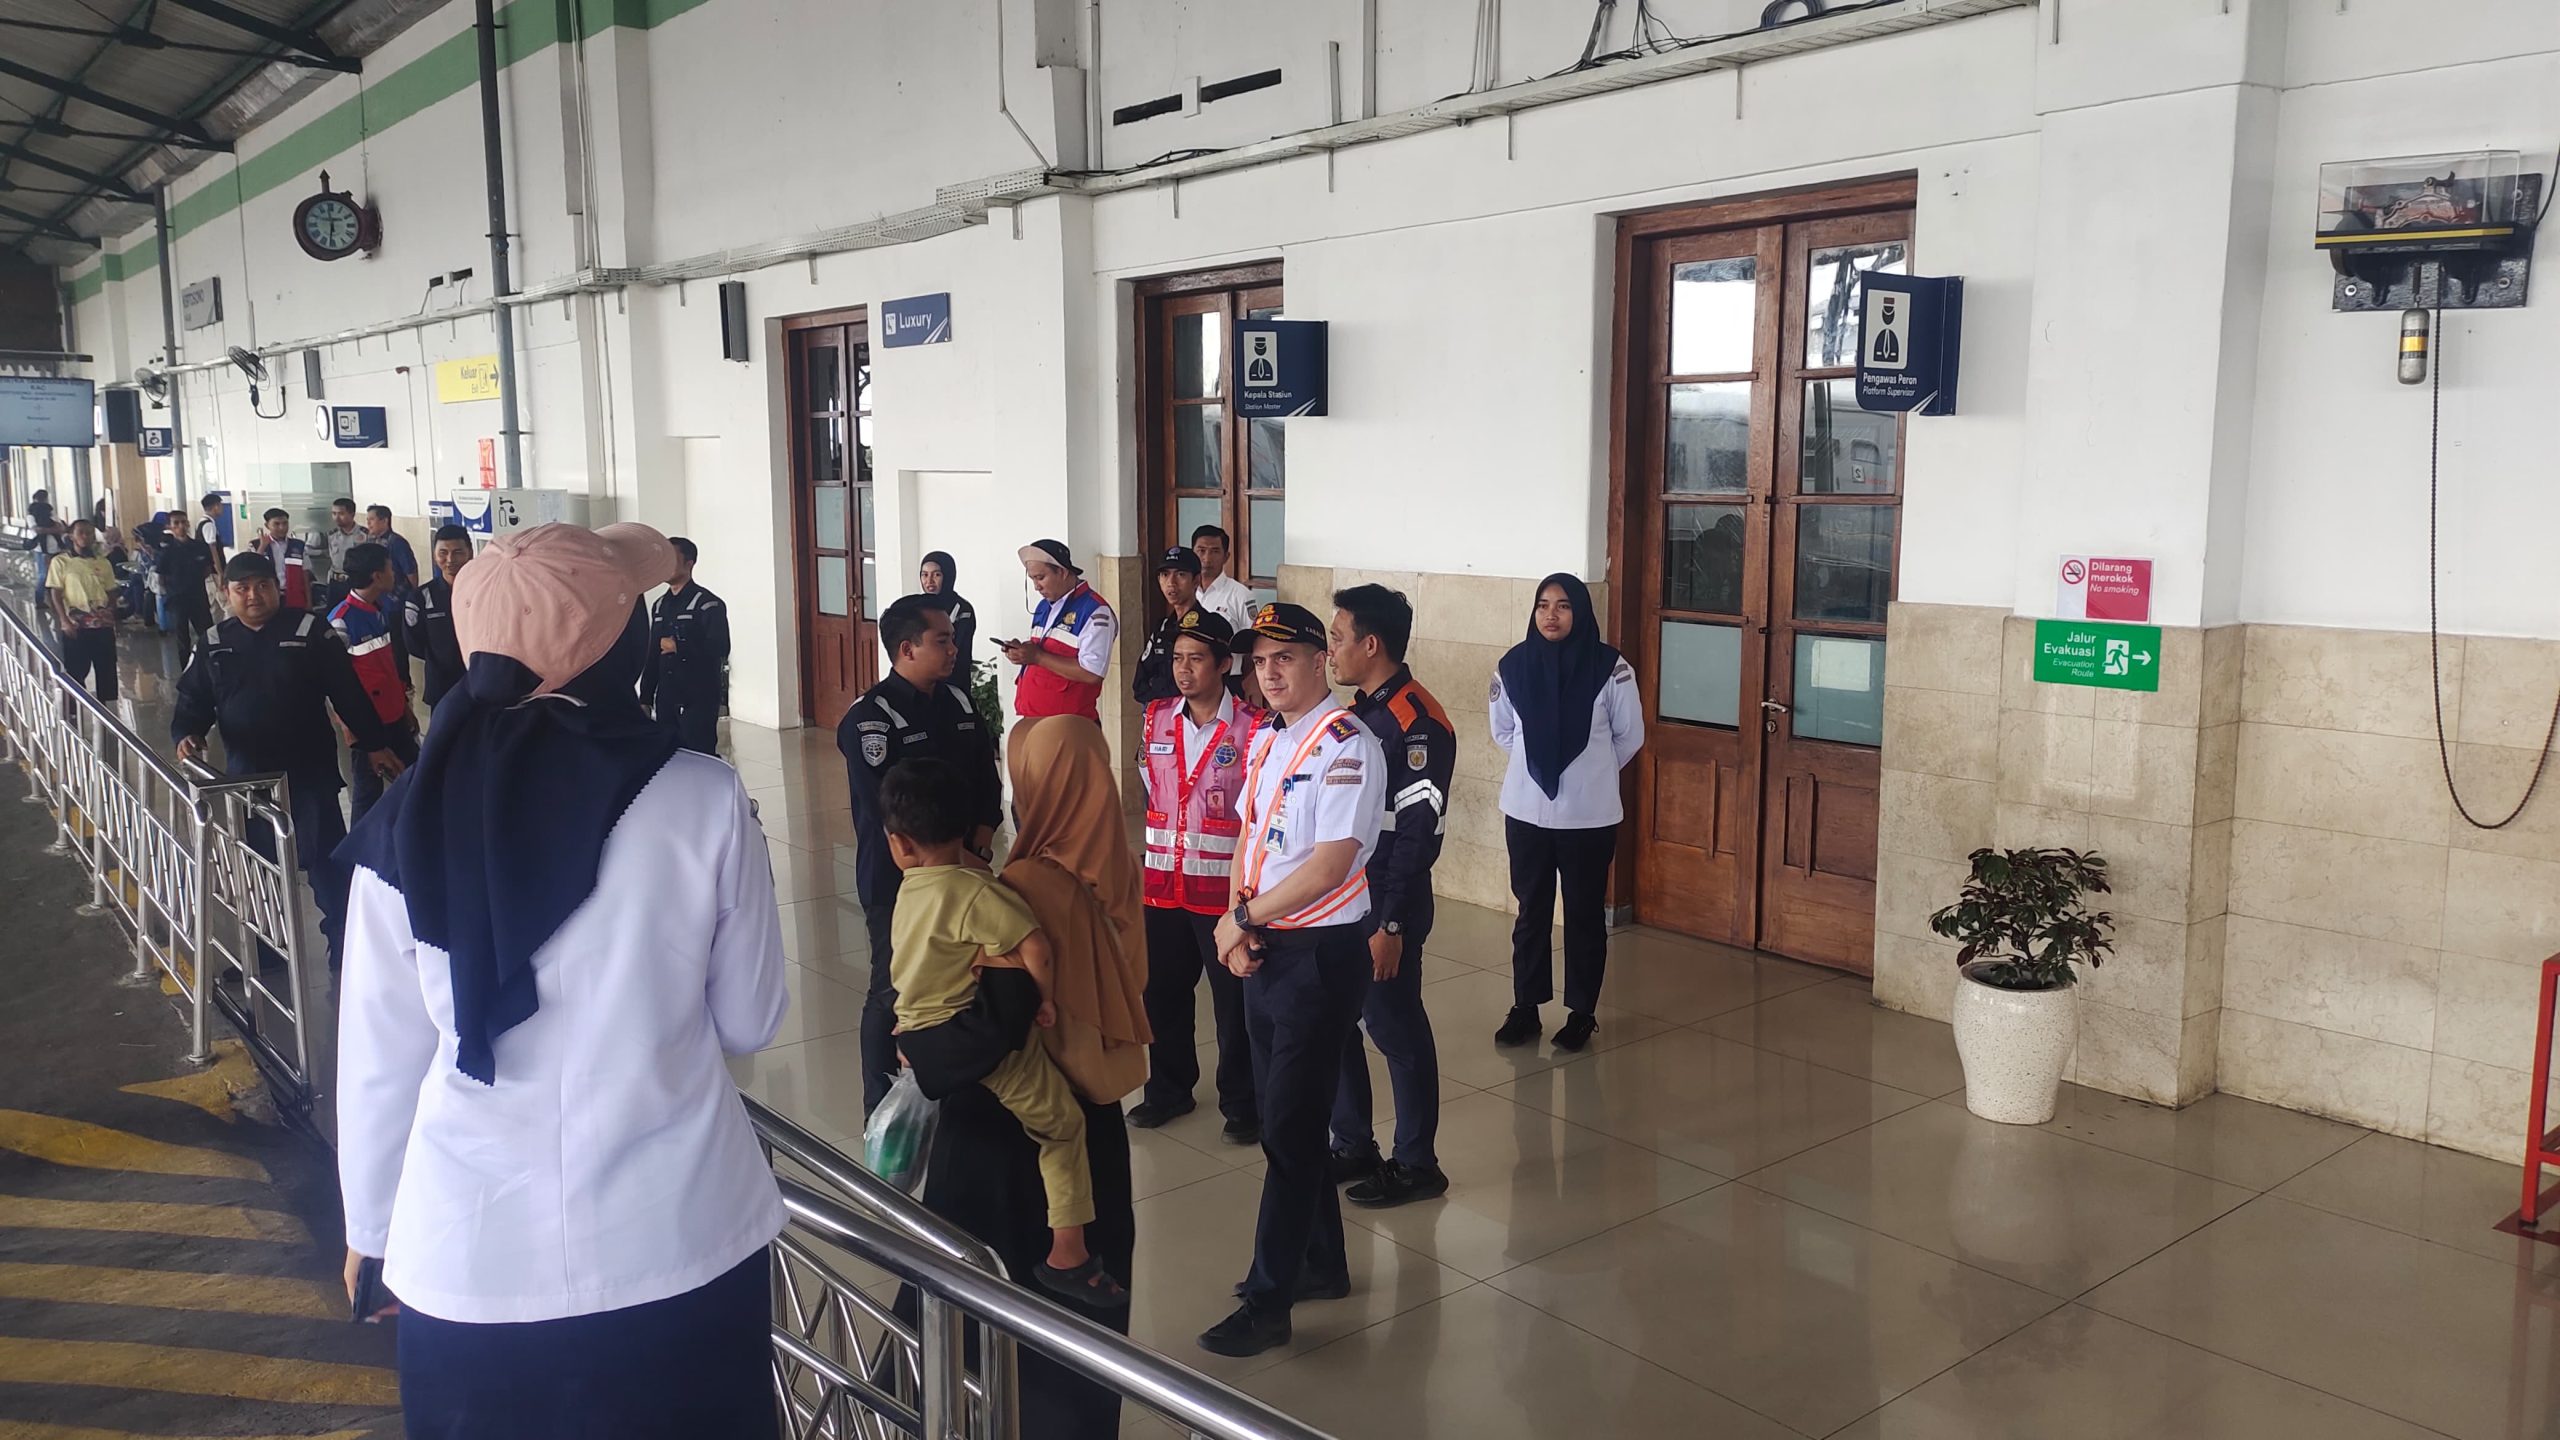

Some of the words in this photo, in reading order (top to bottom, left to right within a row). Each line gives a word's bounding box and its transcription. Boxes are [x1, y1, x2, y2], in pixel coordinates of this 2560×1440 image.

[899, 312, 932, 330] Luxury
[1863, 372, 1897, 386] Pengawas
[1898, 373, 1918, 385] Peron
[1244, 390, 1267, 400] Kepala
[1268, 390, 1293, 399] Stasiun
[1862, 386, 1886, 396] Platform
[1887, 386, 1916, 398] Supervisor
[2091, 561, 2133, 575] Dilarang
[2090, 573, 2134, 583] merokok
[2089, 584, 2102, 593] No
[2103, 585, 2140, 596] smoking
[2066, 631, 2097, 643] Jalur
[2043, 642, 2096, 657] Evakuasi
[2053, 657, 2095, 669] Evacuation
[2071, 668, 2095, 678] Route
